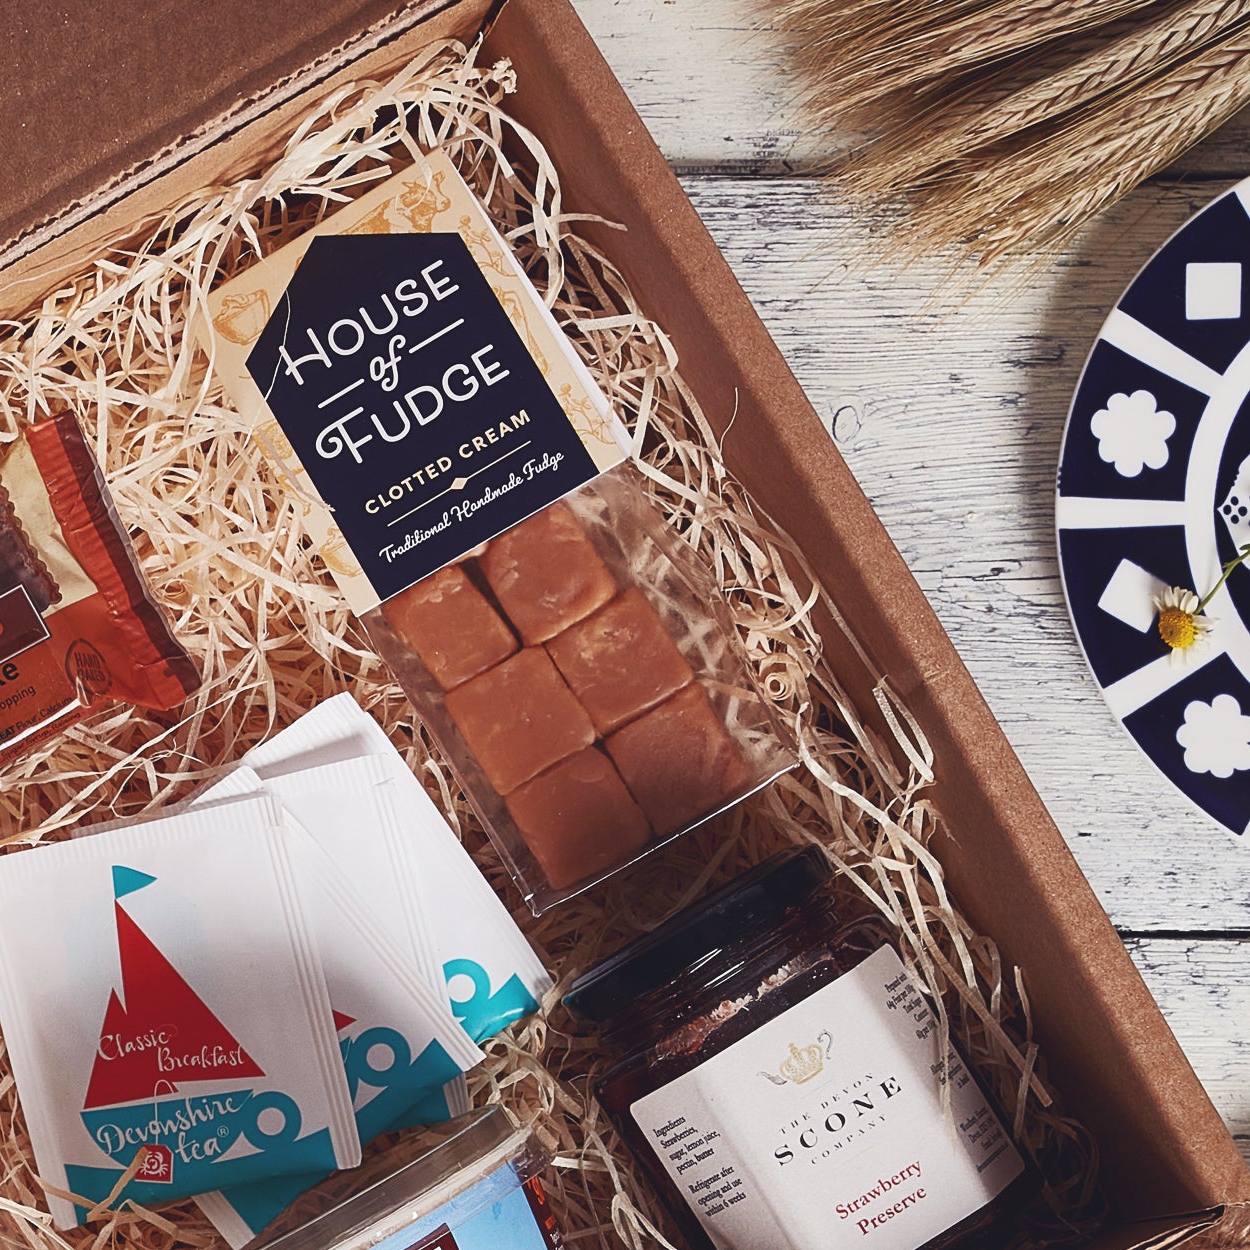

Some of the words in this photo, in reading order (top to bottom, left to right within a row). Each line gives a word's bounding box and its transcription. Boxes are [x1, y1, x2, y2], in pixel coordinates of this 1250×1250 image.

[277, 258, 460, 385] HOUSE
[371, 336, 403, 389] of
[317, 344, 510, 464] FUDGE
[362, 454, 454, 516] CLOTTED
[457, 409, 531, 460] CREAM
[377, 511, 452, 563] Traditional
[448, 470, 523, 522] Handmade
[520, 451, 564, 480] Fudge
[98, 1029, 168, 1061] Classic
[157, 1046, 244, 1071] Breakfast
[96, 1097, 241, 1157] Devonshire
[652, 1115, 686, 1137] Ingredients
[772, 1075, 901, 1165] SCONE
[779, 1112, 811, 1135] THE
[820, 1071, 873, 1108] DEVON
[659, 1126, 697, 1149] Strawberries,
[675, 1158, 696, 1175] pectin,
[694, 1148, 714, 1161] butter
[684, 1138, 704, 1152] lemon
[809, 1113, 887, 1164] COMPANY
[688, 1173, 721, 1193] Refrigerate
[718, 1165, 734, 1177] after
[696, 1188, 722, 1207] opening
[719, 1181, 732, 1193] and
[730, 1178, 742, 1187] use
[703, 1201, 724, 1217] within
[727, 1190, 746, 1205] weeks
[834, 1159, 923, 1220] Strawberry
[856, 1186, 927, 1236] Preserve
